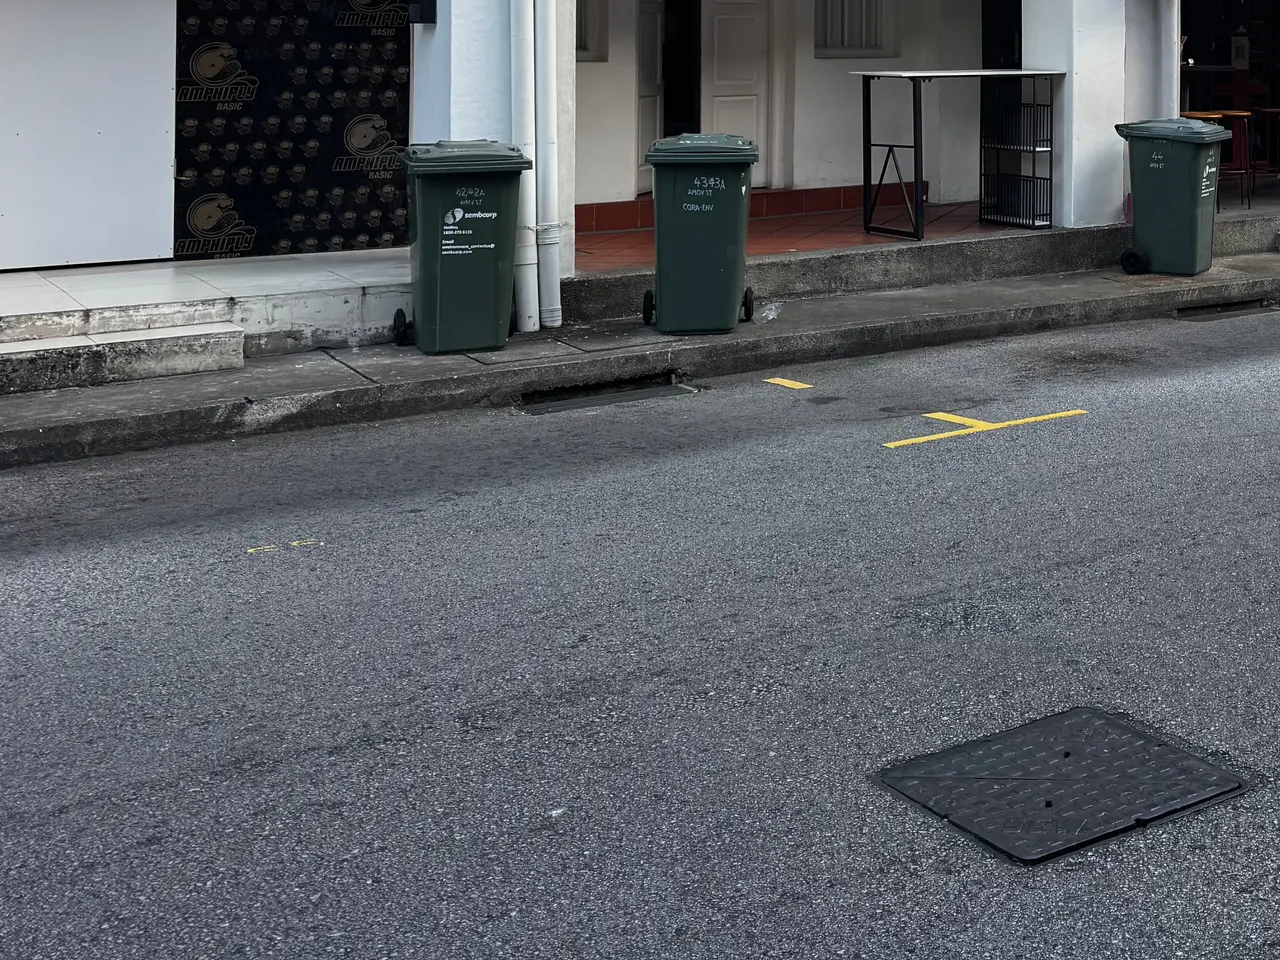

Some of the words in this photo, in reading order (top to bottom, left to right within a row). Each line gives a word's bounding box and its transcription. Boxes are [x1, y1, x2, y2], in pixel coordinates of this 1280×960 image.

[371, 28, 396, 36] BASIC
[216, 102, 243, 111] BASIC
[368, 171, 393, 179] BASIC
[464, 211, 497, 220] sembcorp
